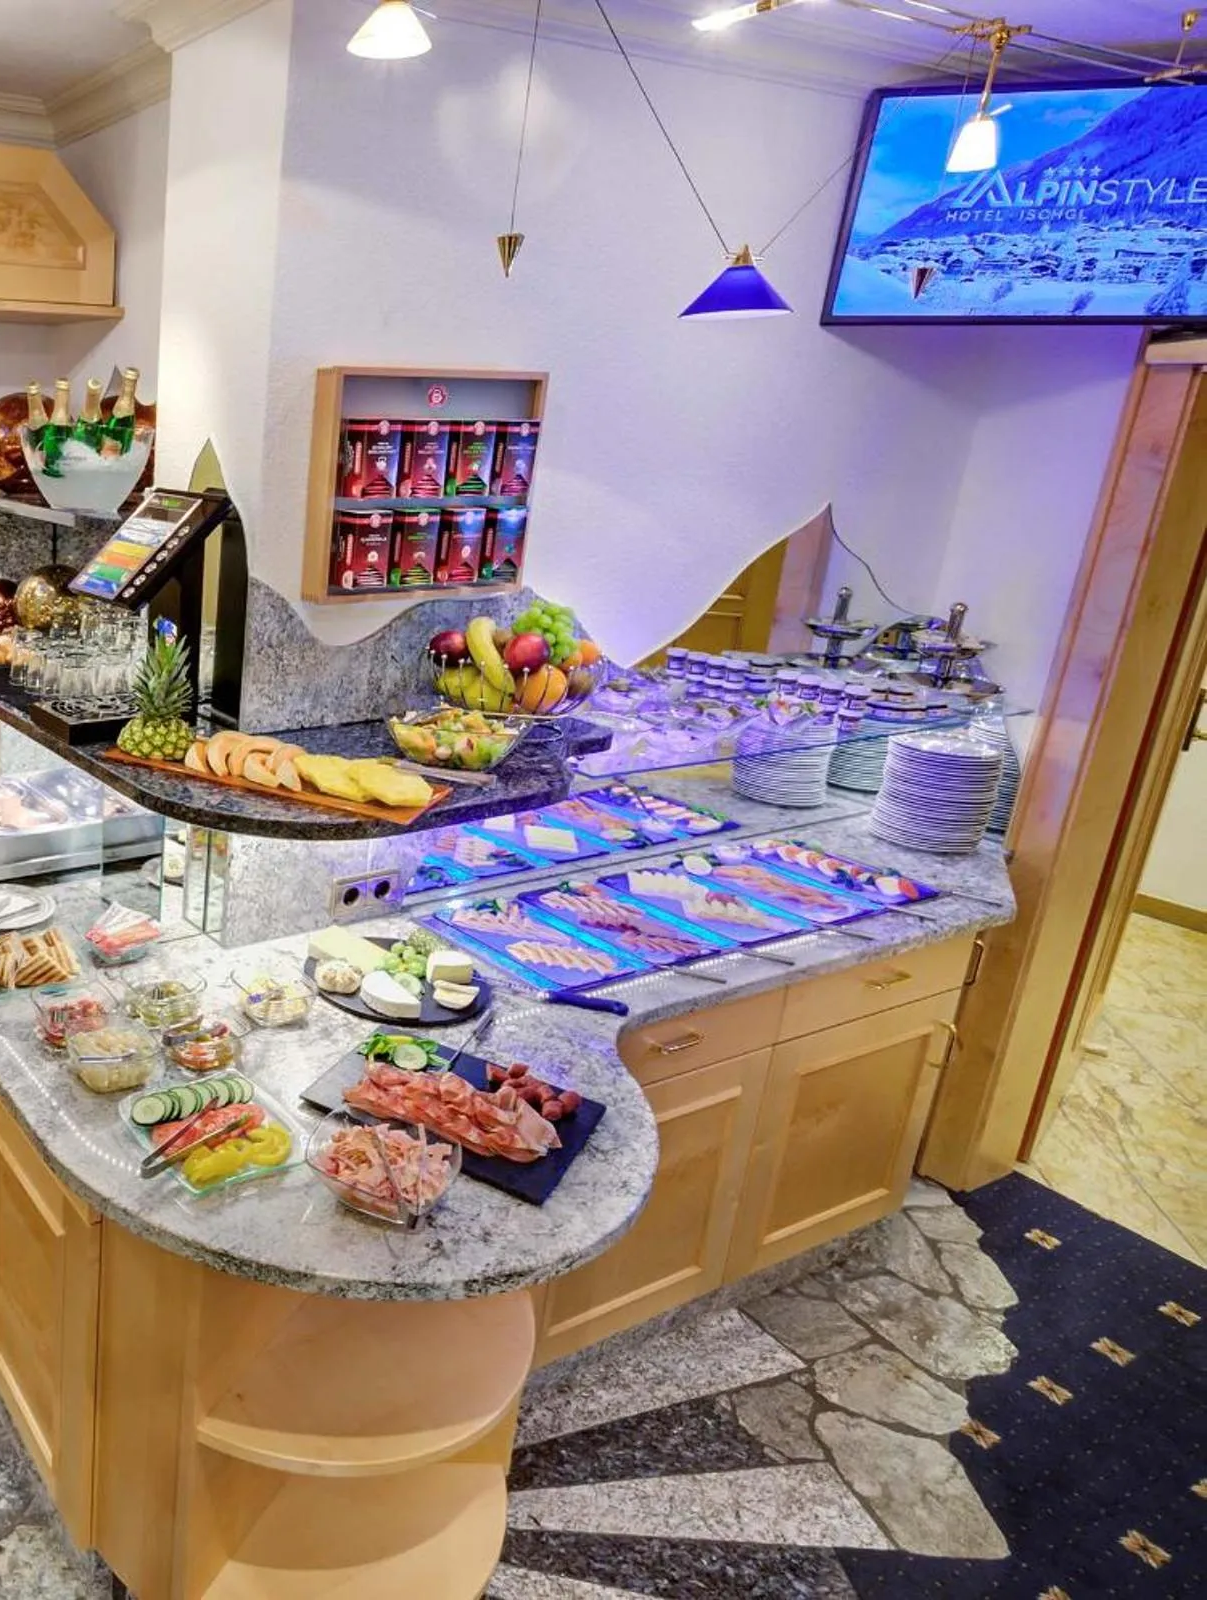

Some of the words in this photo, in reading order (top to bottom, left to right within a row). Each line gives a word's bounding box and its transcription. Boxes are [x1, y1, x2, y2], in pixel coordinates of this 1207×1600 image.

[950, 169, 1207, 207] ALPINSTYLE
[946, 209, 1004, 223] HOTEL
[1019, 208, 1087, 221] ISCHGL
